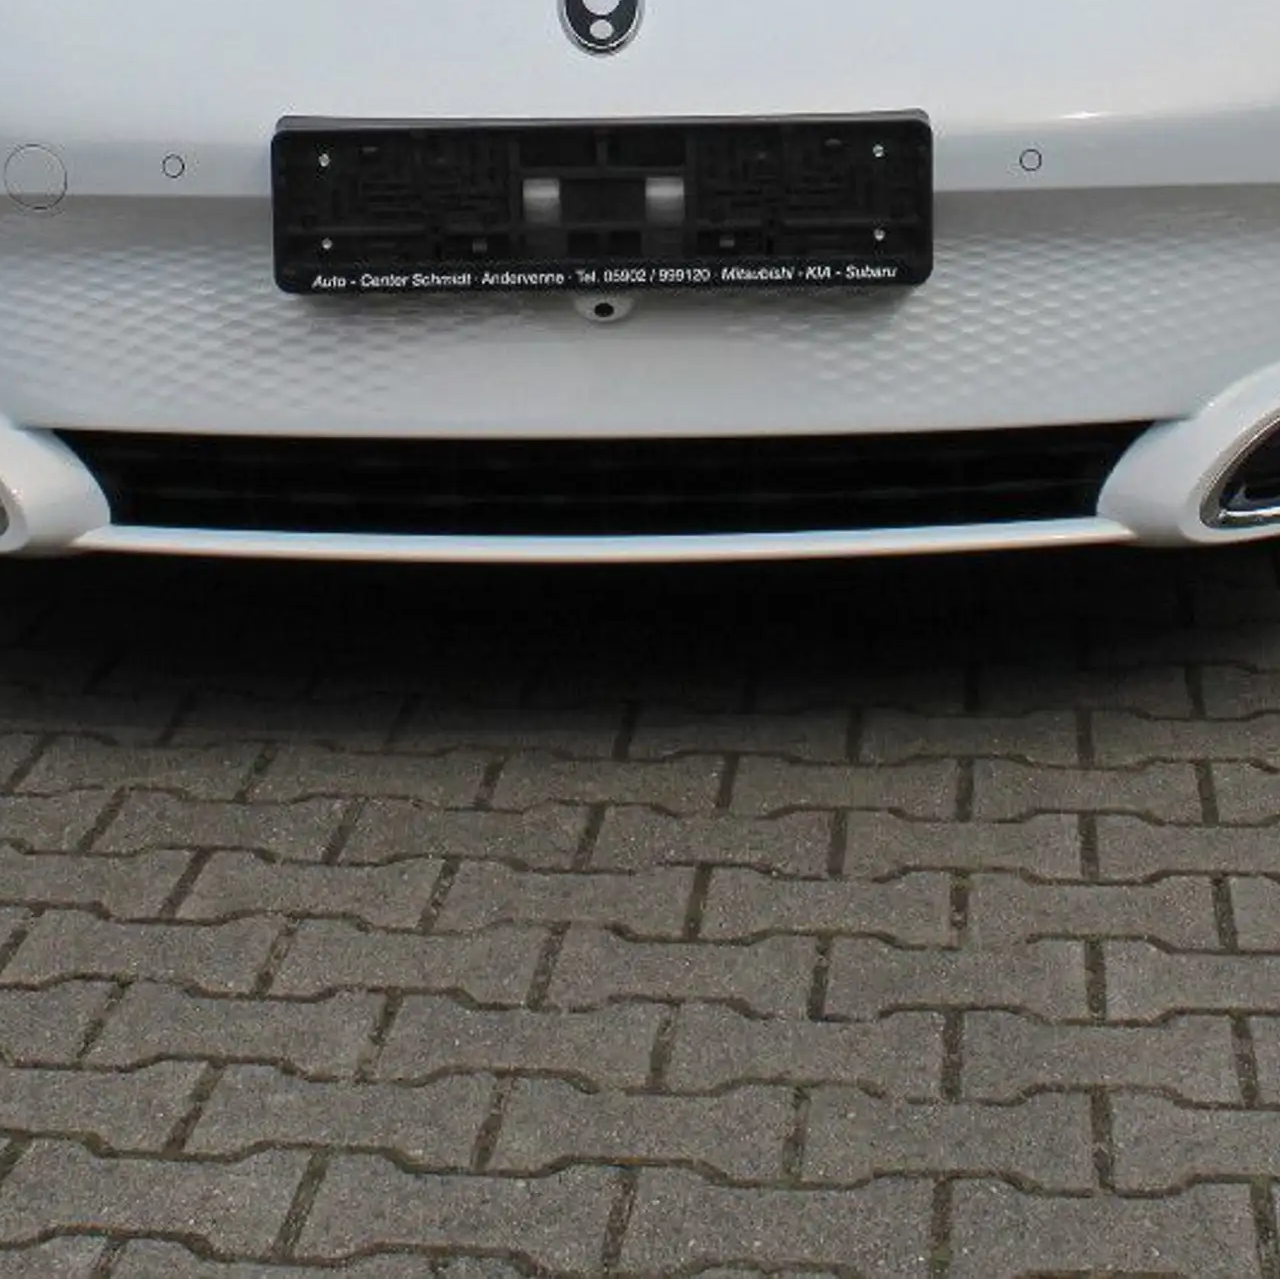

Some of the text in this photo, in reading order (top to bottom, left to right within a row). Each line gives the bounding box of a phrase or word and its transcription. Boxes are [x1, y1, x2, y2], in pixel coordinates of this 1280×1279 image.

[361, 274, 408, 287] Center
[412, 272, 472, 287] Schmidt
[577, 270, 601, 284] Tel.
[721, 266, 794, 281] Mitsubishi
[805, 266, 831, 280] KIA
[845, 265, 898, 279] Subaru
